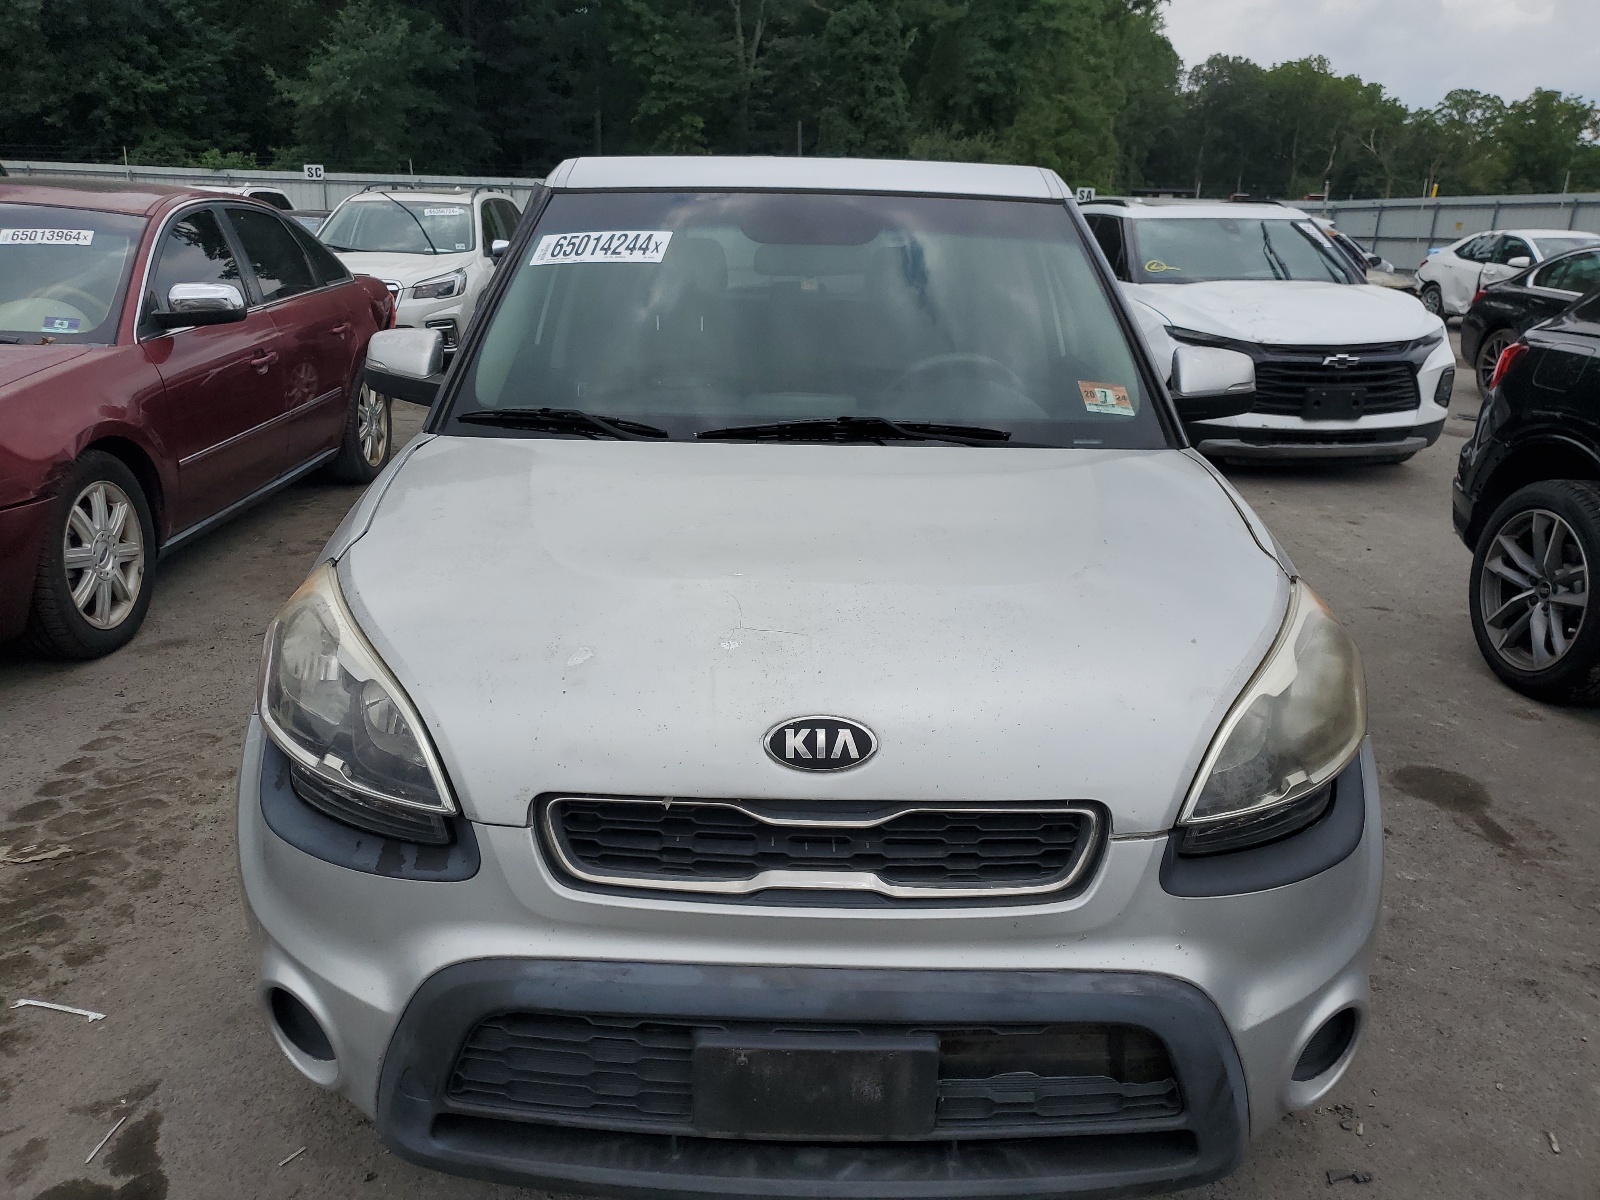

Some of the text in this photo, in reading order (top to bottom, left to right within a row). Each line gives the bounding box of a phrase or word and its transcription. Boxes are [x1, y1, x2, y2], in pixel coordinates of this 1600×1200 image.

[307, 167, 322, 178] SC
[1079, 190, 1092, 201] SA
[1083, 390, 1095, 399] 20
[1100, 390, 1108, 402] 7
[784, 728, 860, 759] KIA
